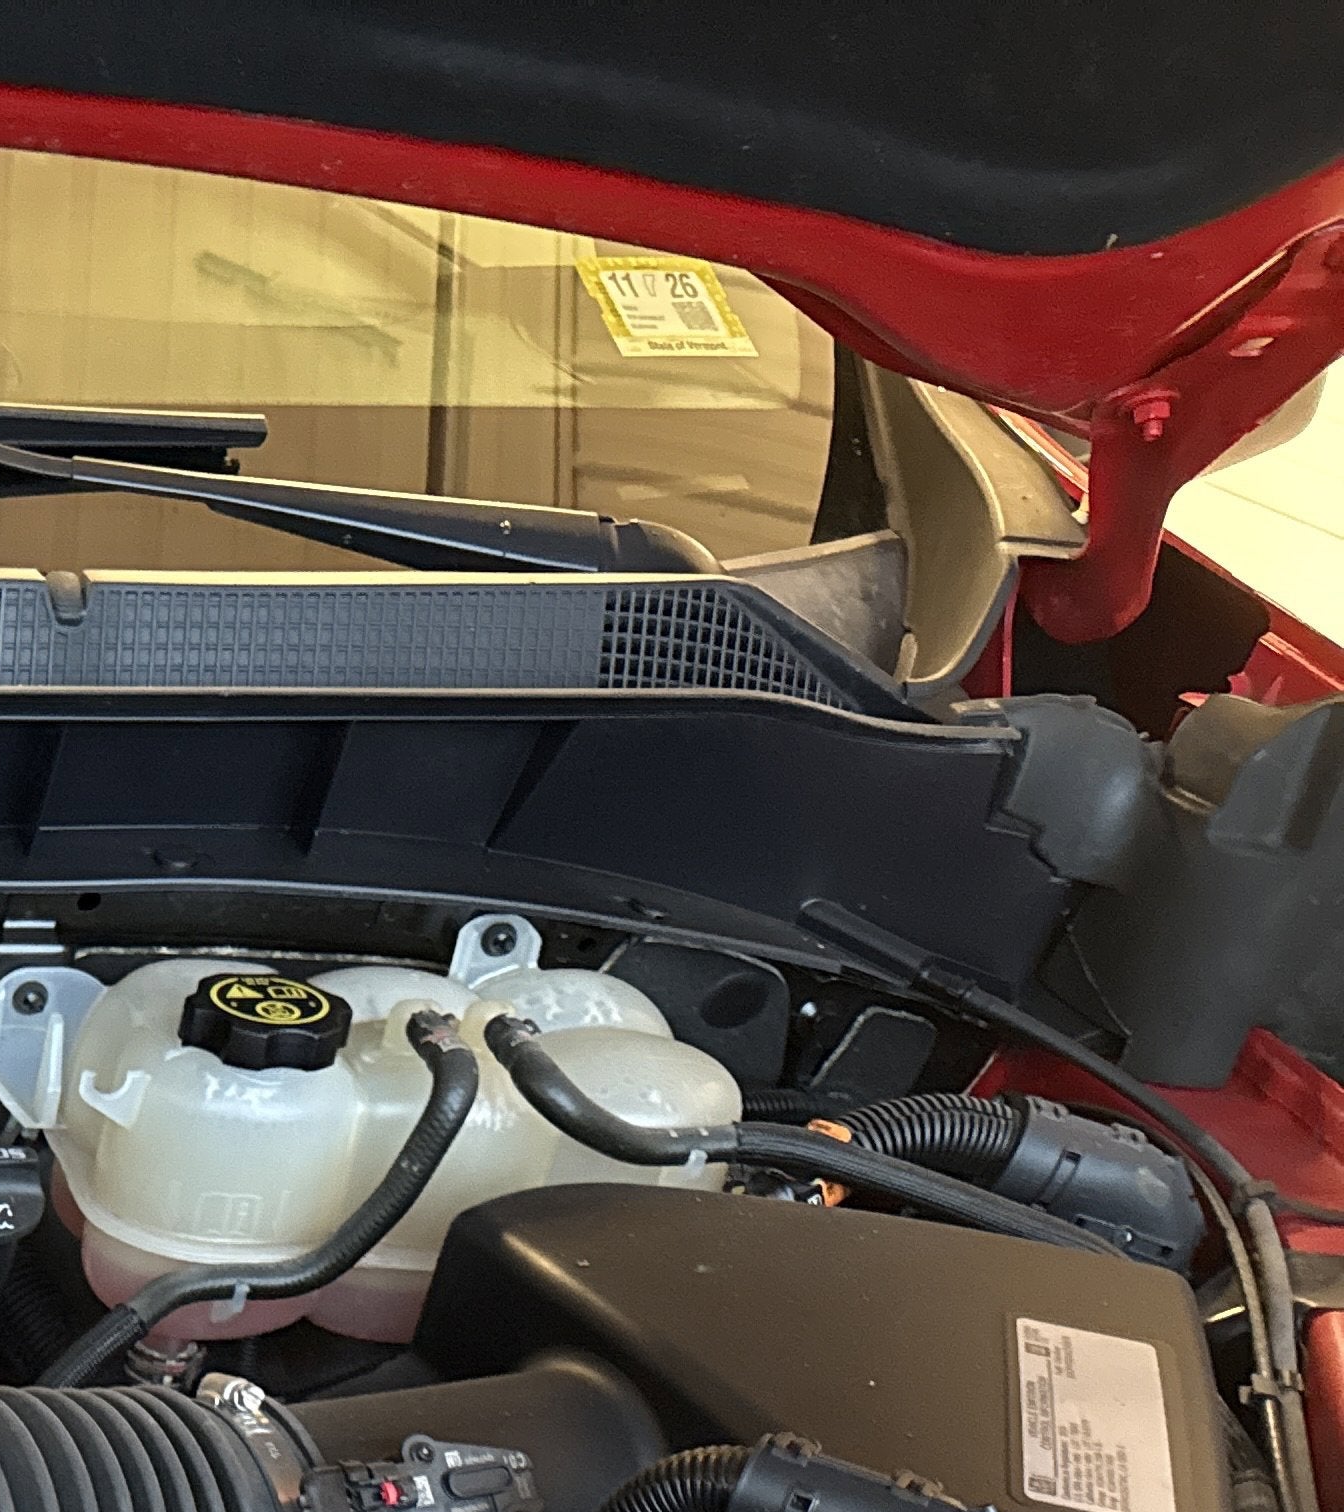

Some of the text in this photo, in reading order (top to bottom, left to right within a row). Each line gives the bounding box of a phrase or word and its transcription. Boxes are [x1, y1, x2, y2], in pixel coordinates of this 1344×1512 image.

[608, 271, 699, 299] 11 26
[648, 340, 728, 352] State of Vermont
